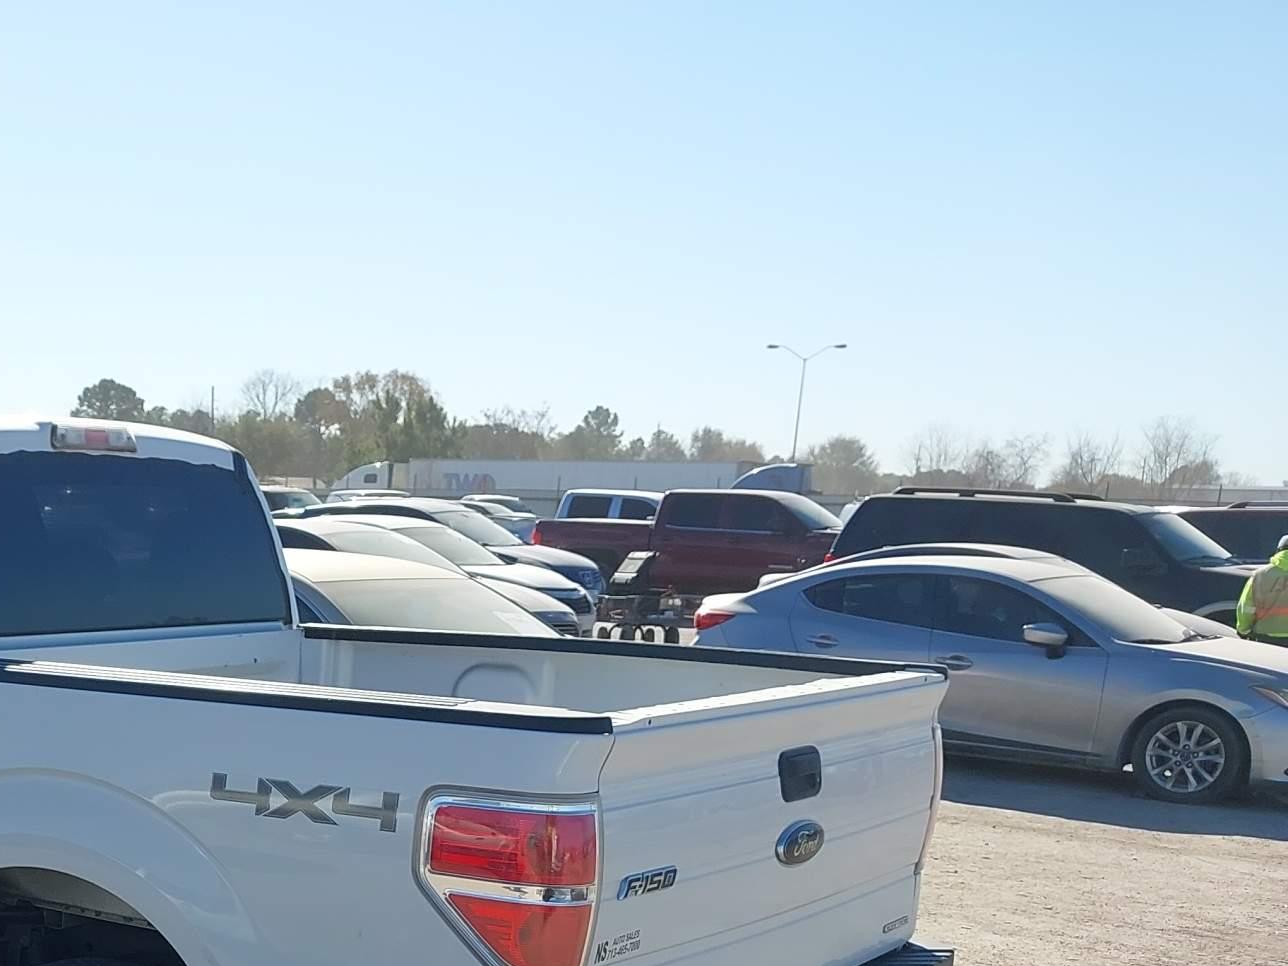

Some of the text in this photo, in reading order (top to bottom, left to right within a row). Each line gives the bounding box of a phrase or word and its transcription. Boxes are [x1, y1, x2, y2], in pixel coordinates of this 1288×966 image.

[794, 831, 819, 856] Ford
[594, 941, 609, 964] NS
[626, 929, 641, 941] SALES
